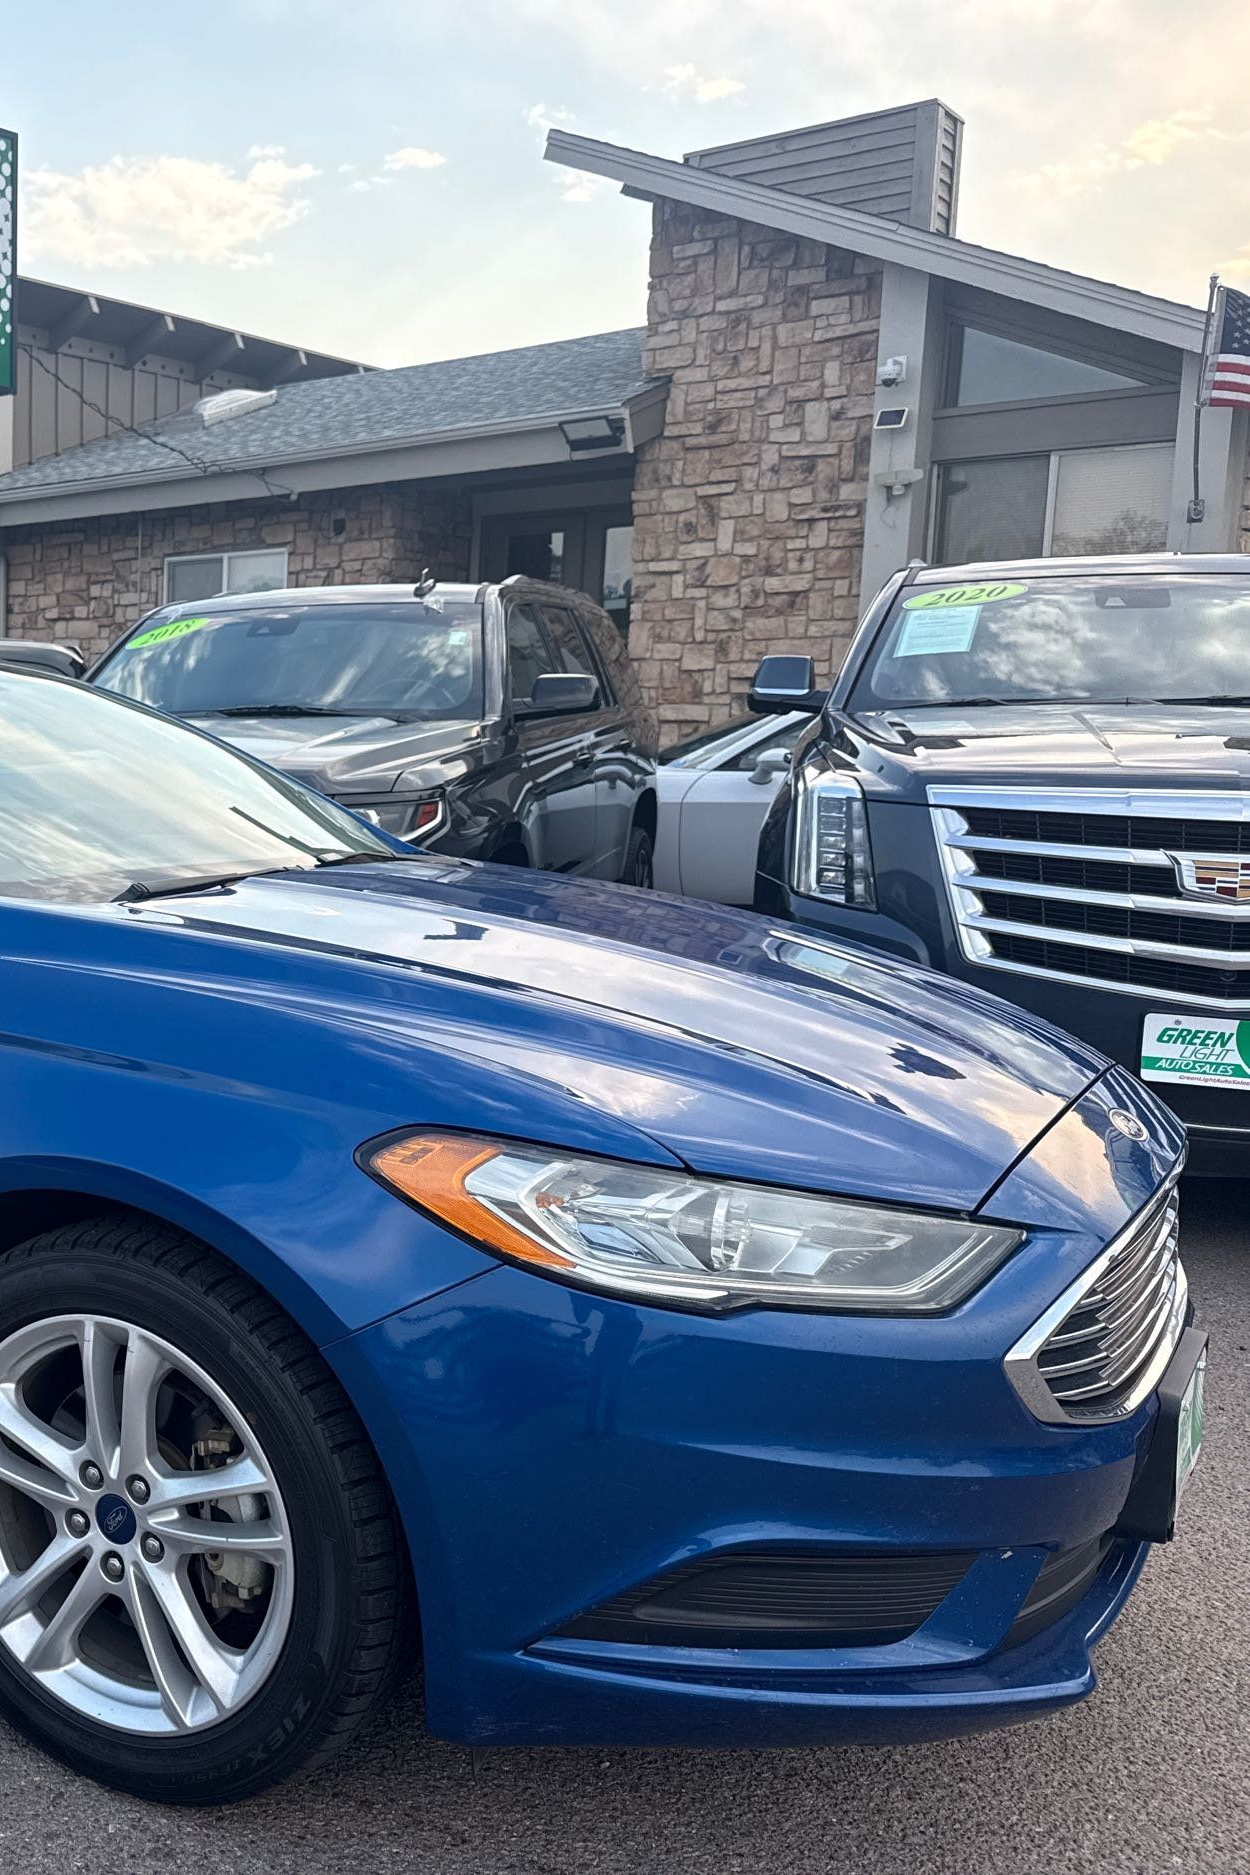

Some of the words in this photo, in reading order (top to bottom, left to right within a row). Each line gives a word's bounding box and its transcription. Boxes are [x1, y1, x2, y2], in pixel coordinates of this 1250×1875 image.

[923, 585, 1008, 607] 2020
[141, 619, 196, 645] 2018
[1156, 1027, 1235, 1048] GREEN
[1179, 1046, 1235, 1062] LIGHT
[1155, 1058, 1192, 1070] AUTO
[1190, 1062, 1235, 1075] SALES
[107, 1509, 124, 1531] Ford
